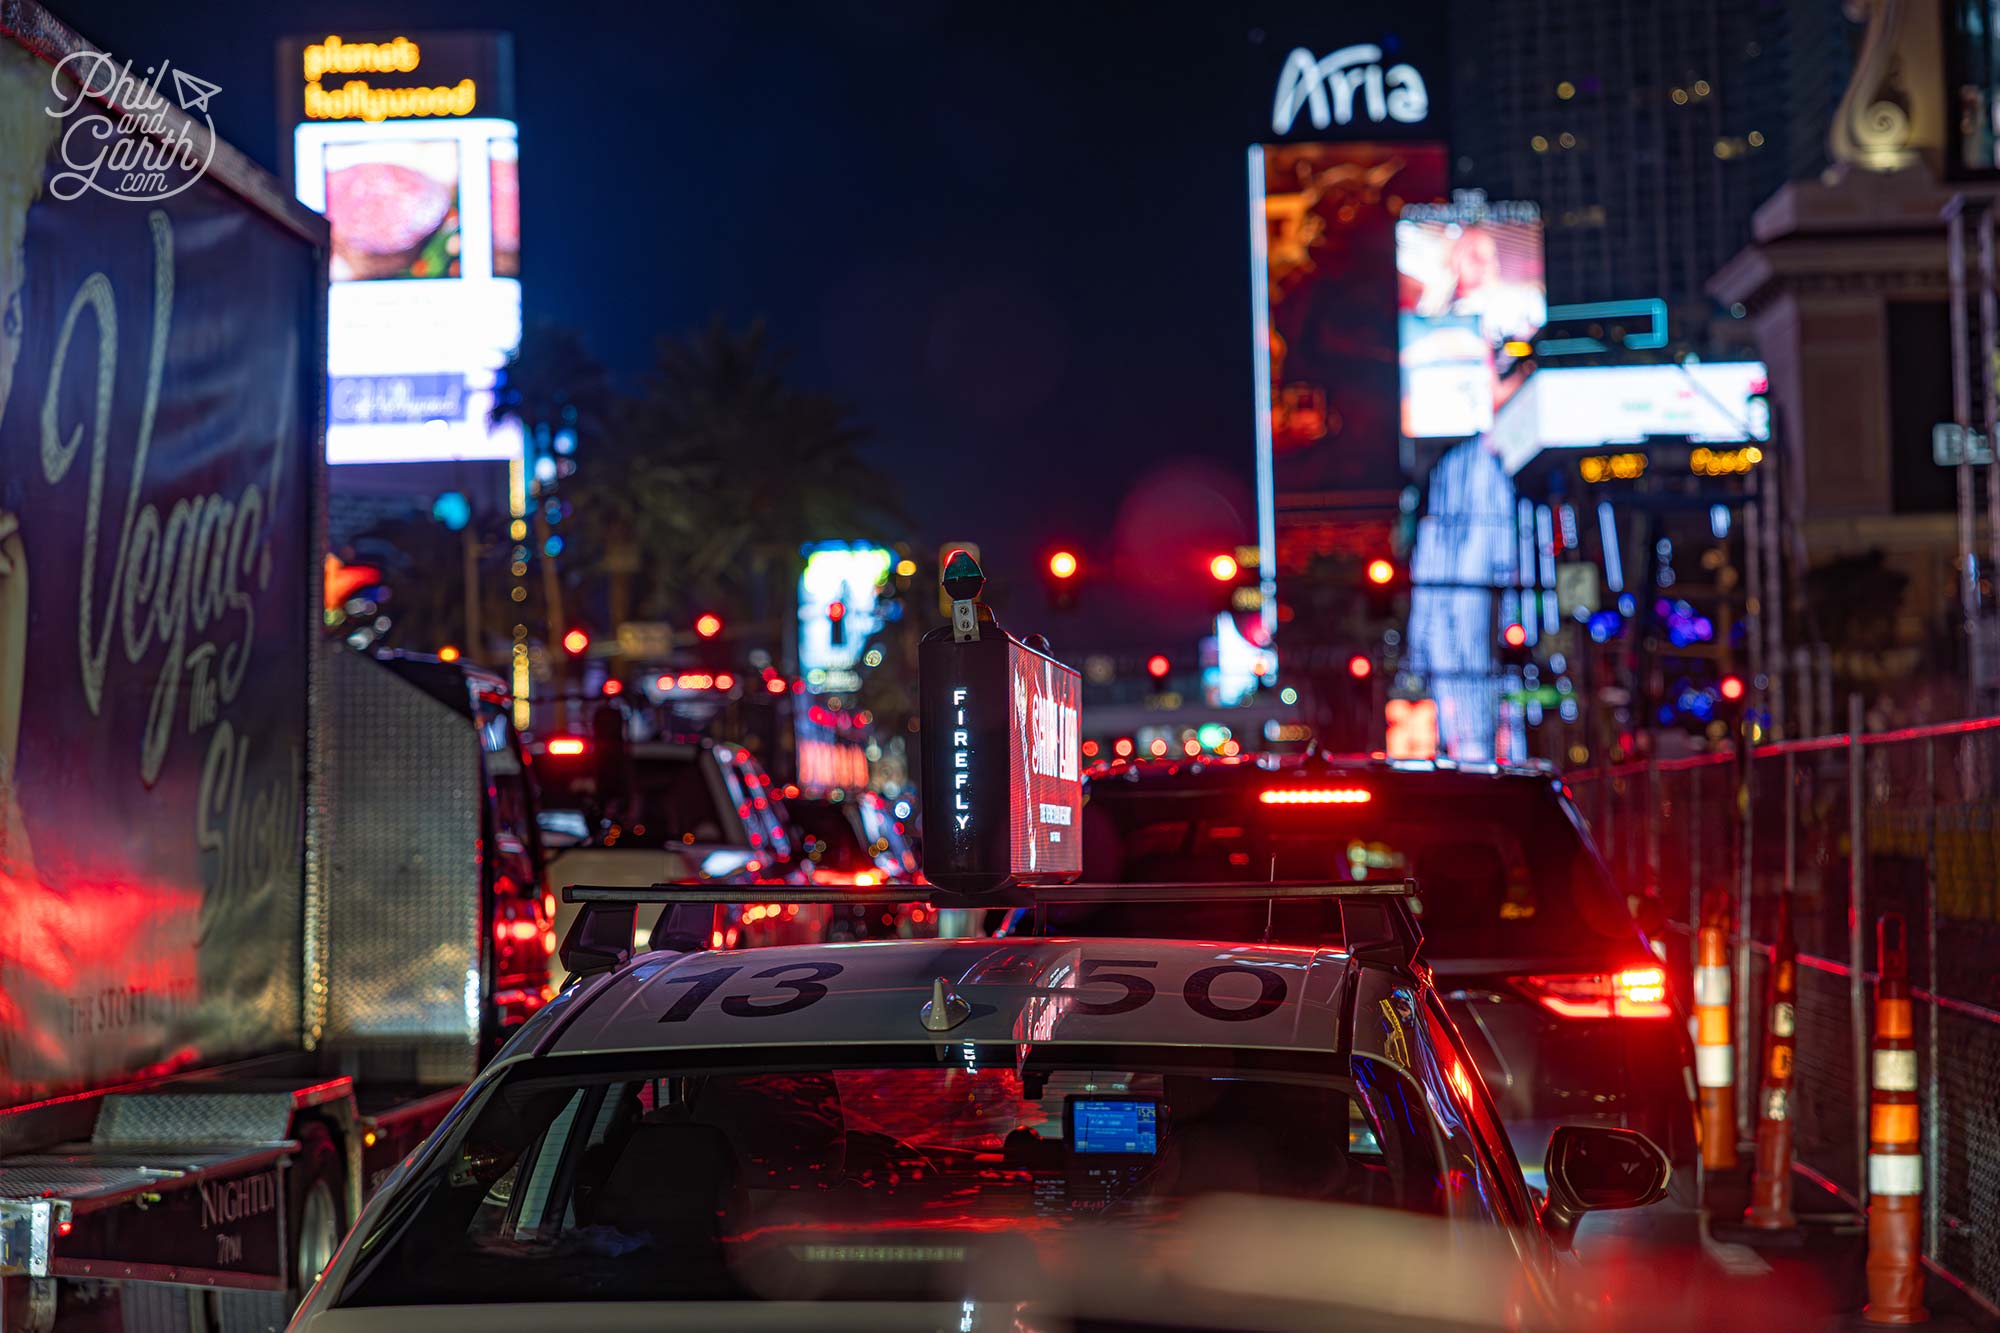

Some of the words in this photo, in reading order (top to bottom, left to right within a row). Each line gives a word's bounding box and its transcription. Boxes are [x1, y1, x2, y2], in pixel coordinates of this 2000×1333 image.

[305, 79, 474, 122] hollywood
[1272, 43, 1429, 135] Aria
[953, 688, 970, 830] FIREFLY
[657, 961, 844, 1024] 13
